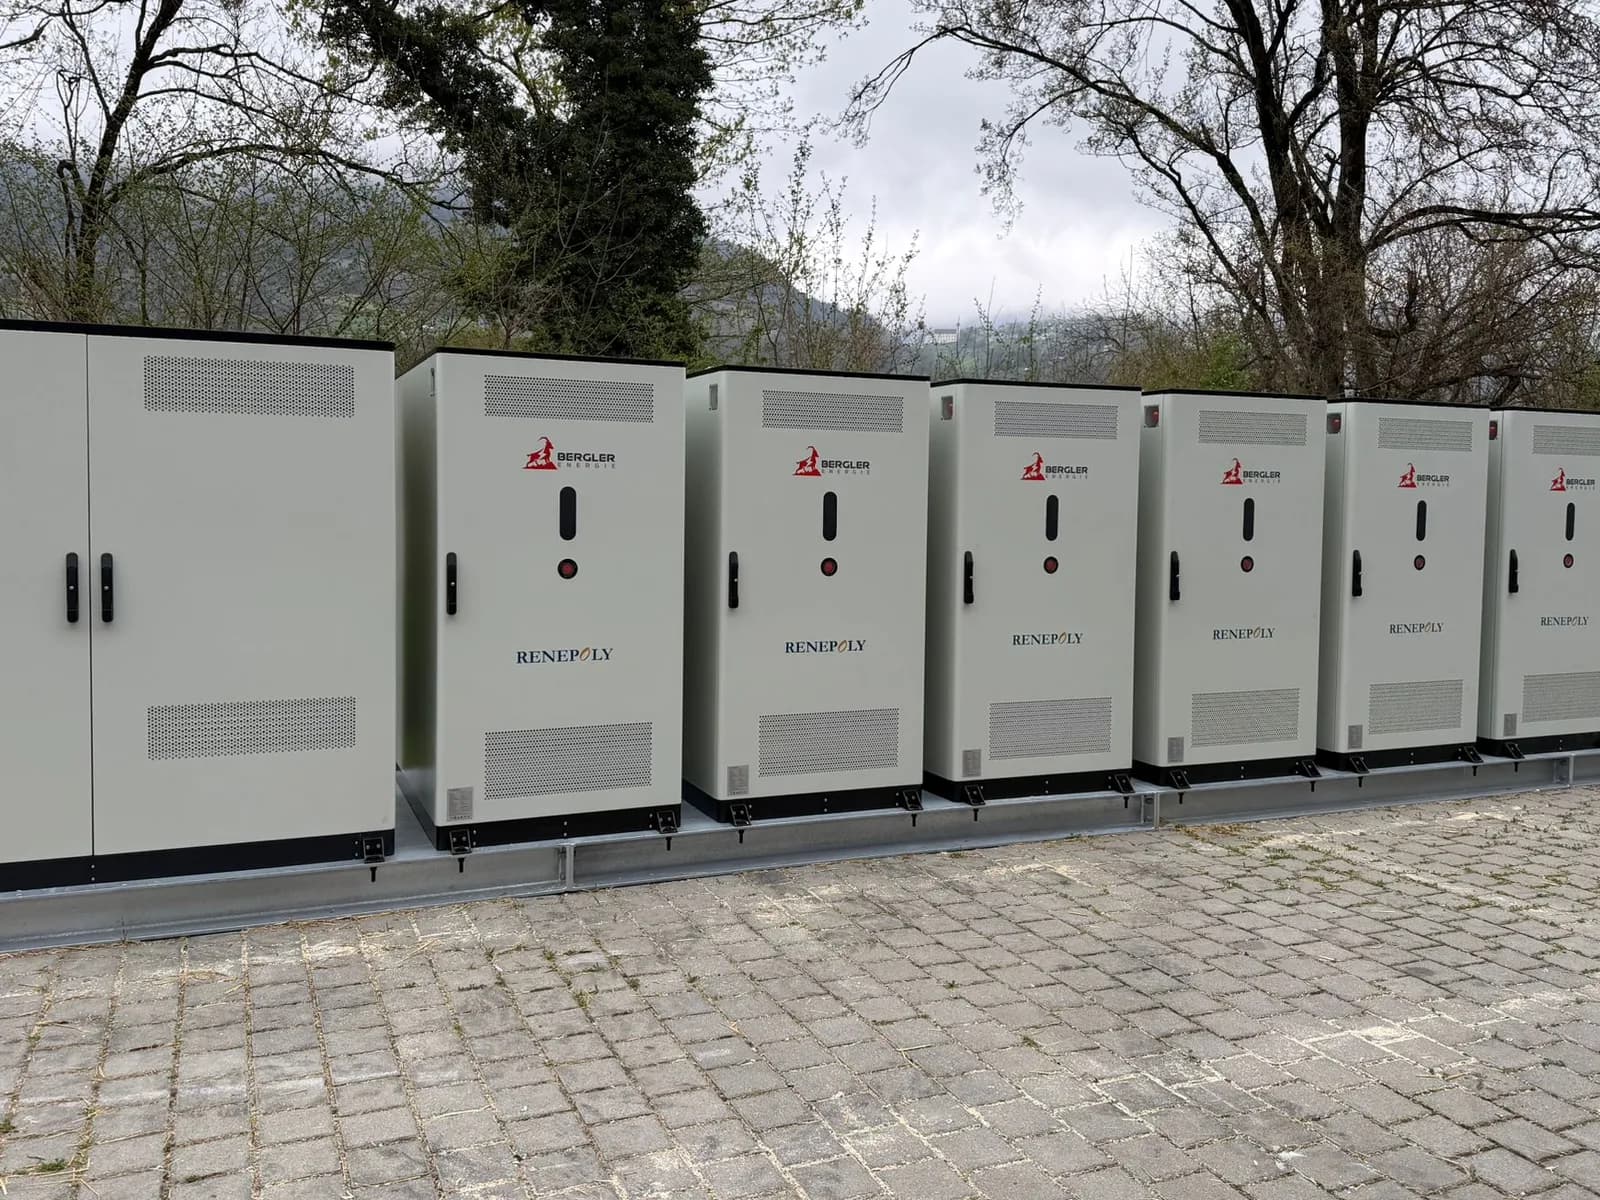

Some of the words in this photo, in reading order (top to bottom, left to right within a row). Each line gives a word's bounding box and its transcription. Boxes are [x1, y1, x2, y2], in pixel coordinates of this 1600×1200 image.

[556, 452, 617, 462] BERGLER
[821, 460, 871, 469] BERGLER
[1045, 465, 1089, 474] BERGLER
[1243, 470, 1281, 478] BERGLER
[1416, 474, 1450, 482] BERGLER
[1540, 615, 1590, 627] RENEPOLY
[1212, 626, 1276, 641] RENEPOLY
[1389, 621, 1445, 634] RENEPOLY
[1012, 631, 1084, 646] RENEPOLY
[784, 639, 867, 654] RENEPOLY
[516, 646, 614, 665] RENEPOLY
